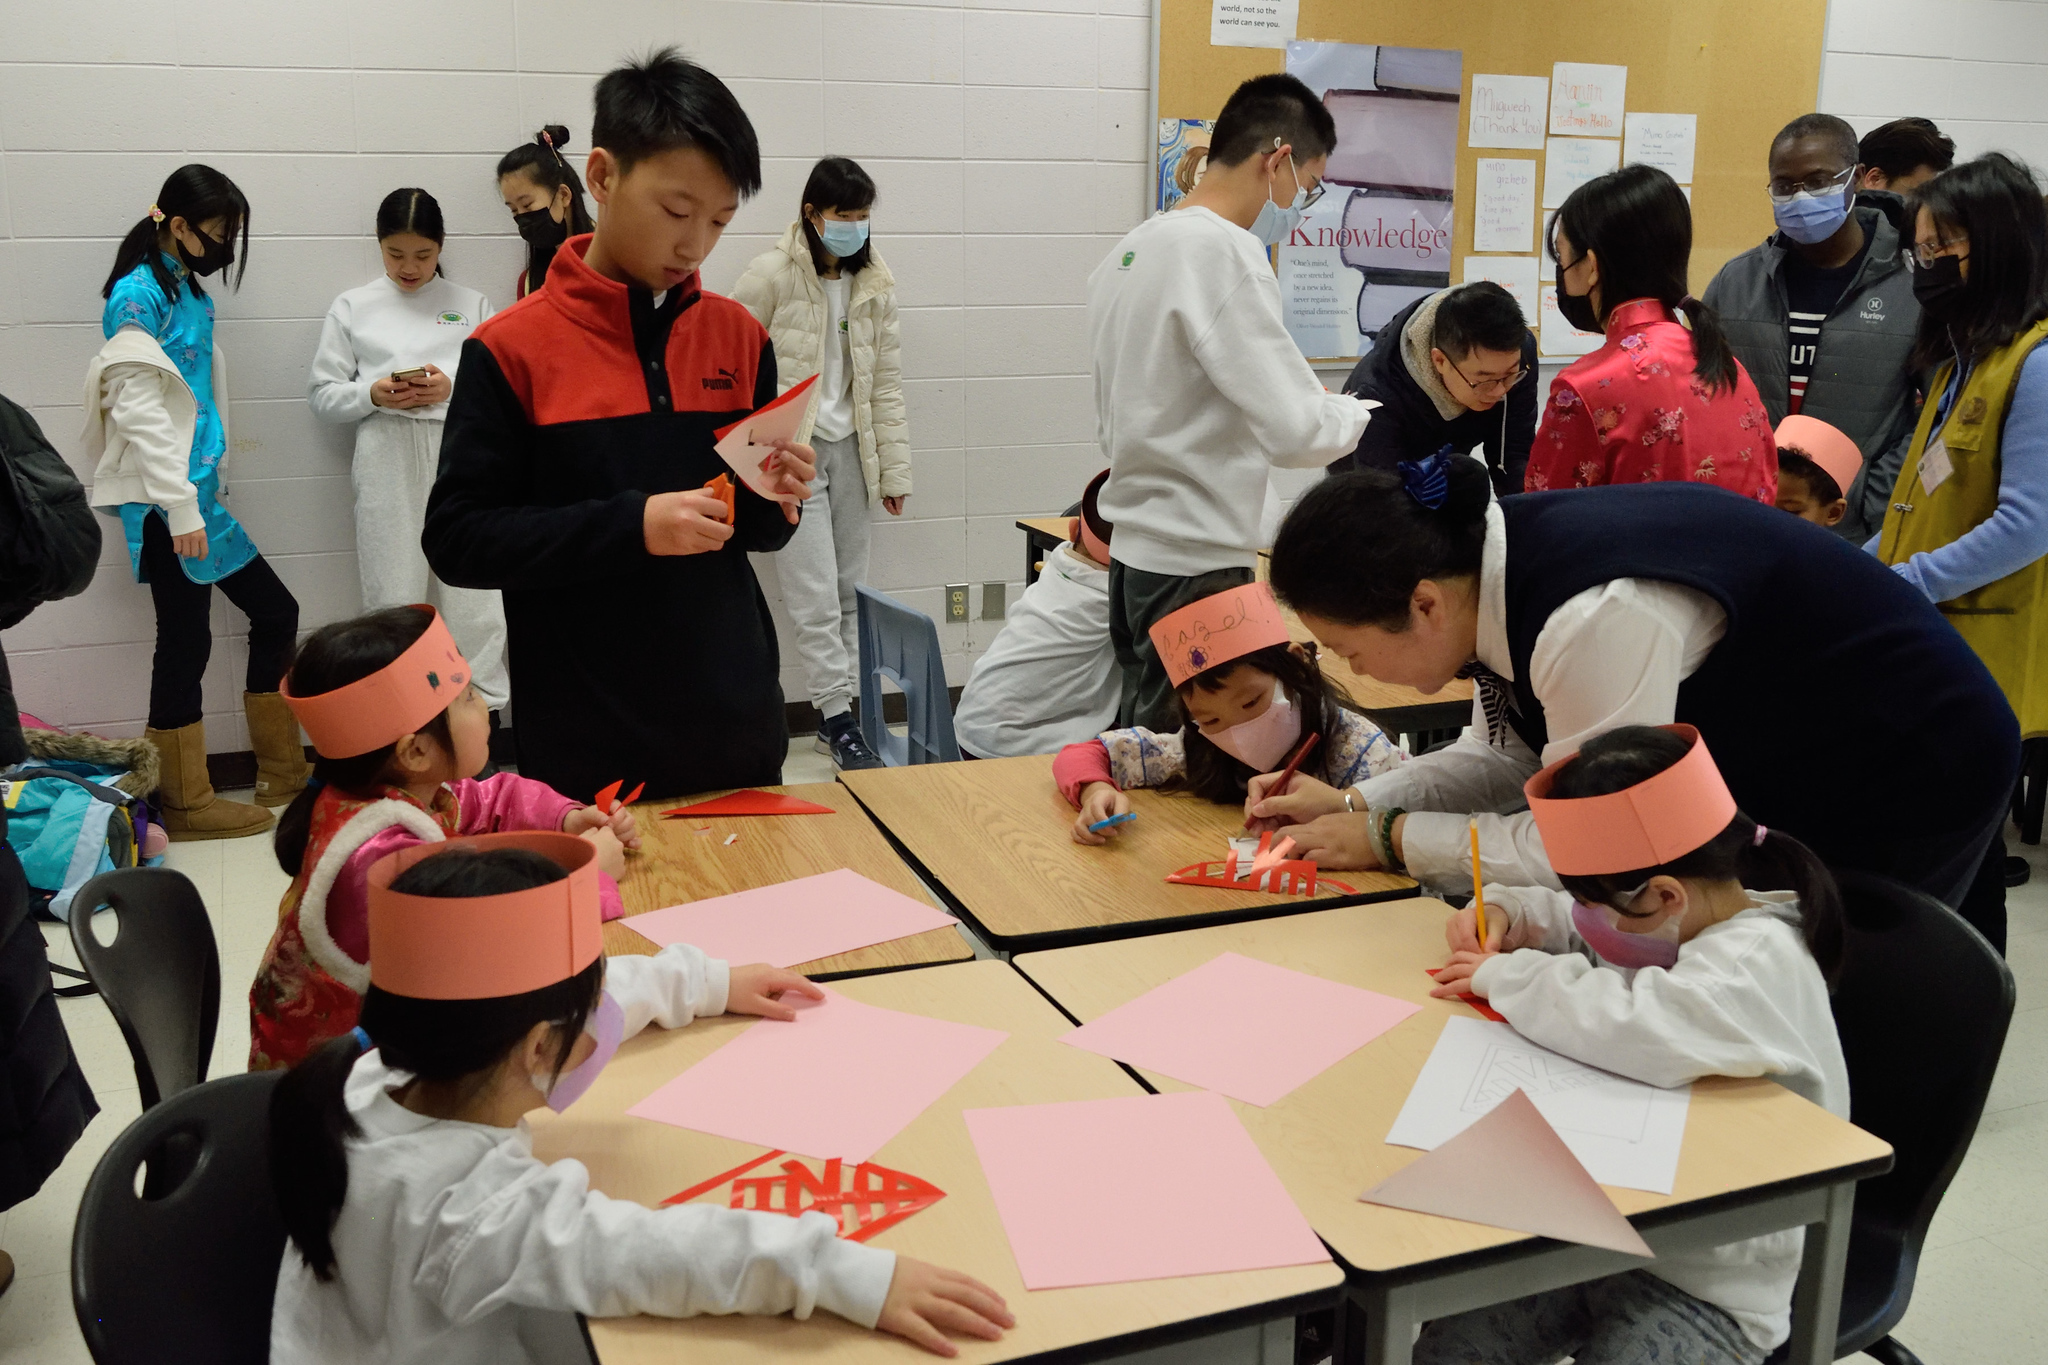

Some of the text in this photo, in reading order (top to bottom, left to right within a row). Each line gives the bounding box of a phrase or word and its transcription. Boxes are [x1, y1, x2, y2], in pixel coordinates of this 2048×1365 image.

[1220, 5, 1242, 13] world,
[1287, 216, 1447, 259] Knowledge
[1311, 259, 1328, 267] mind,
[1293, 284, 1300, 292] by
[1310, 296, 1330, 304] regains
[1293, 308, 1315, 316] original
[1859, 311, 1886, 321] Hurley
[701, 378, 734, 390] PUMA
